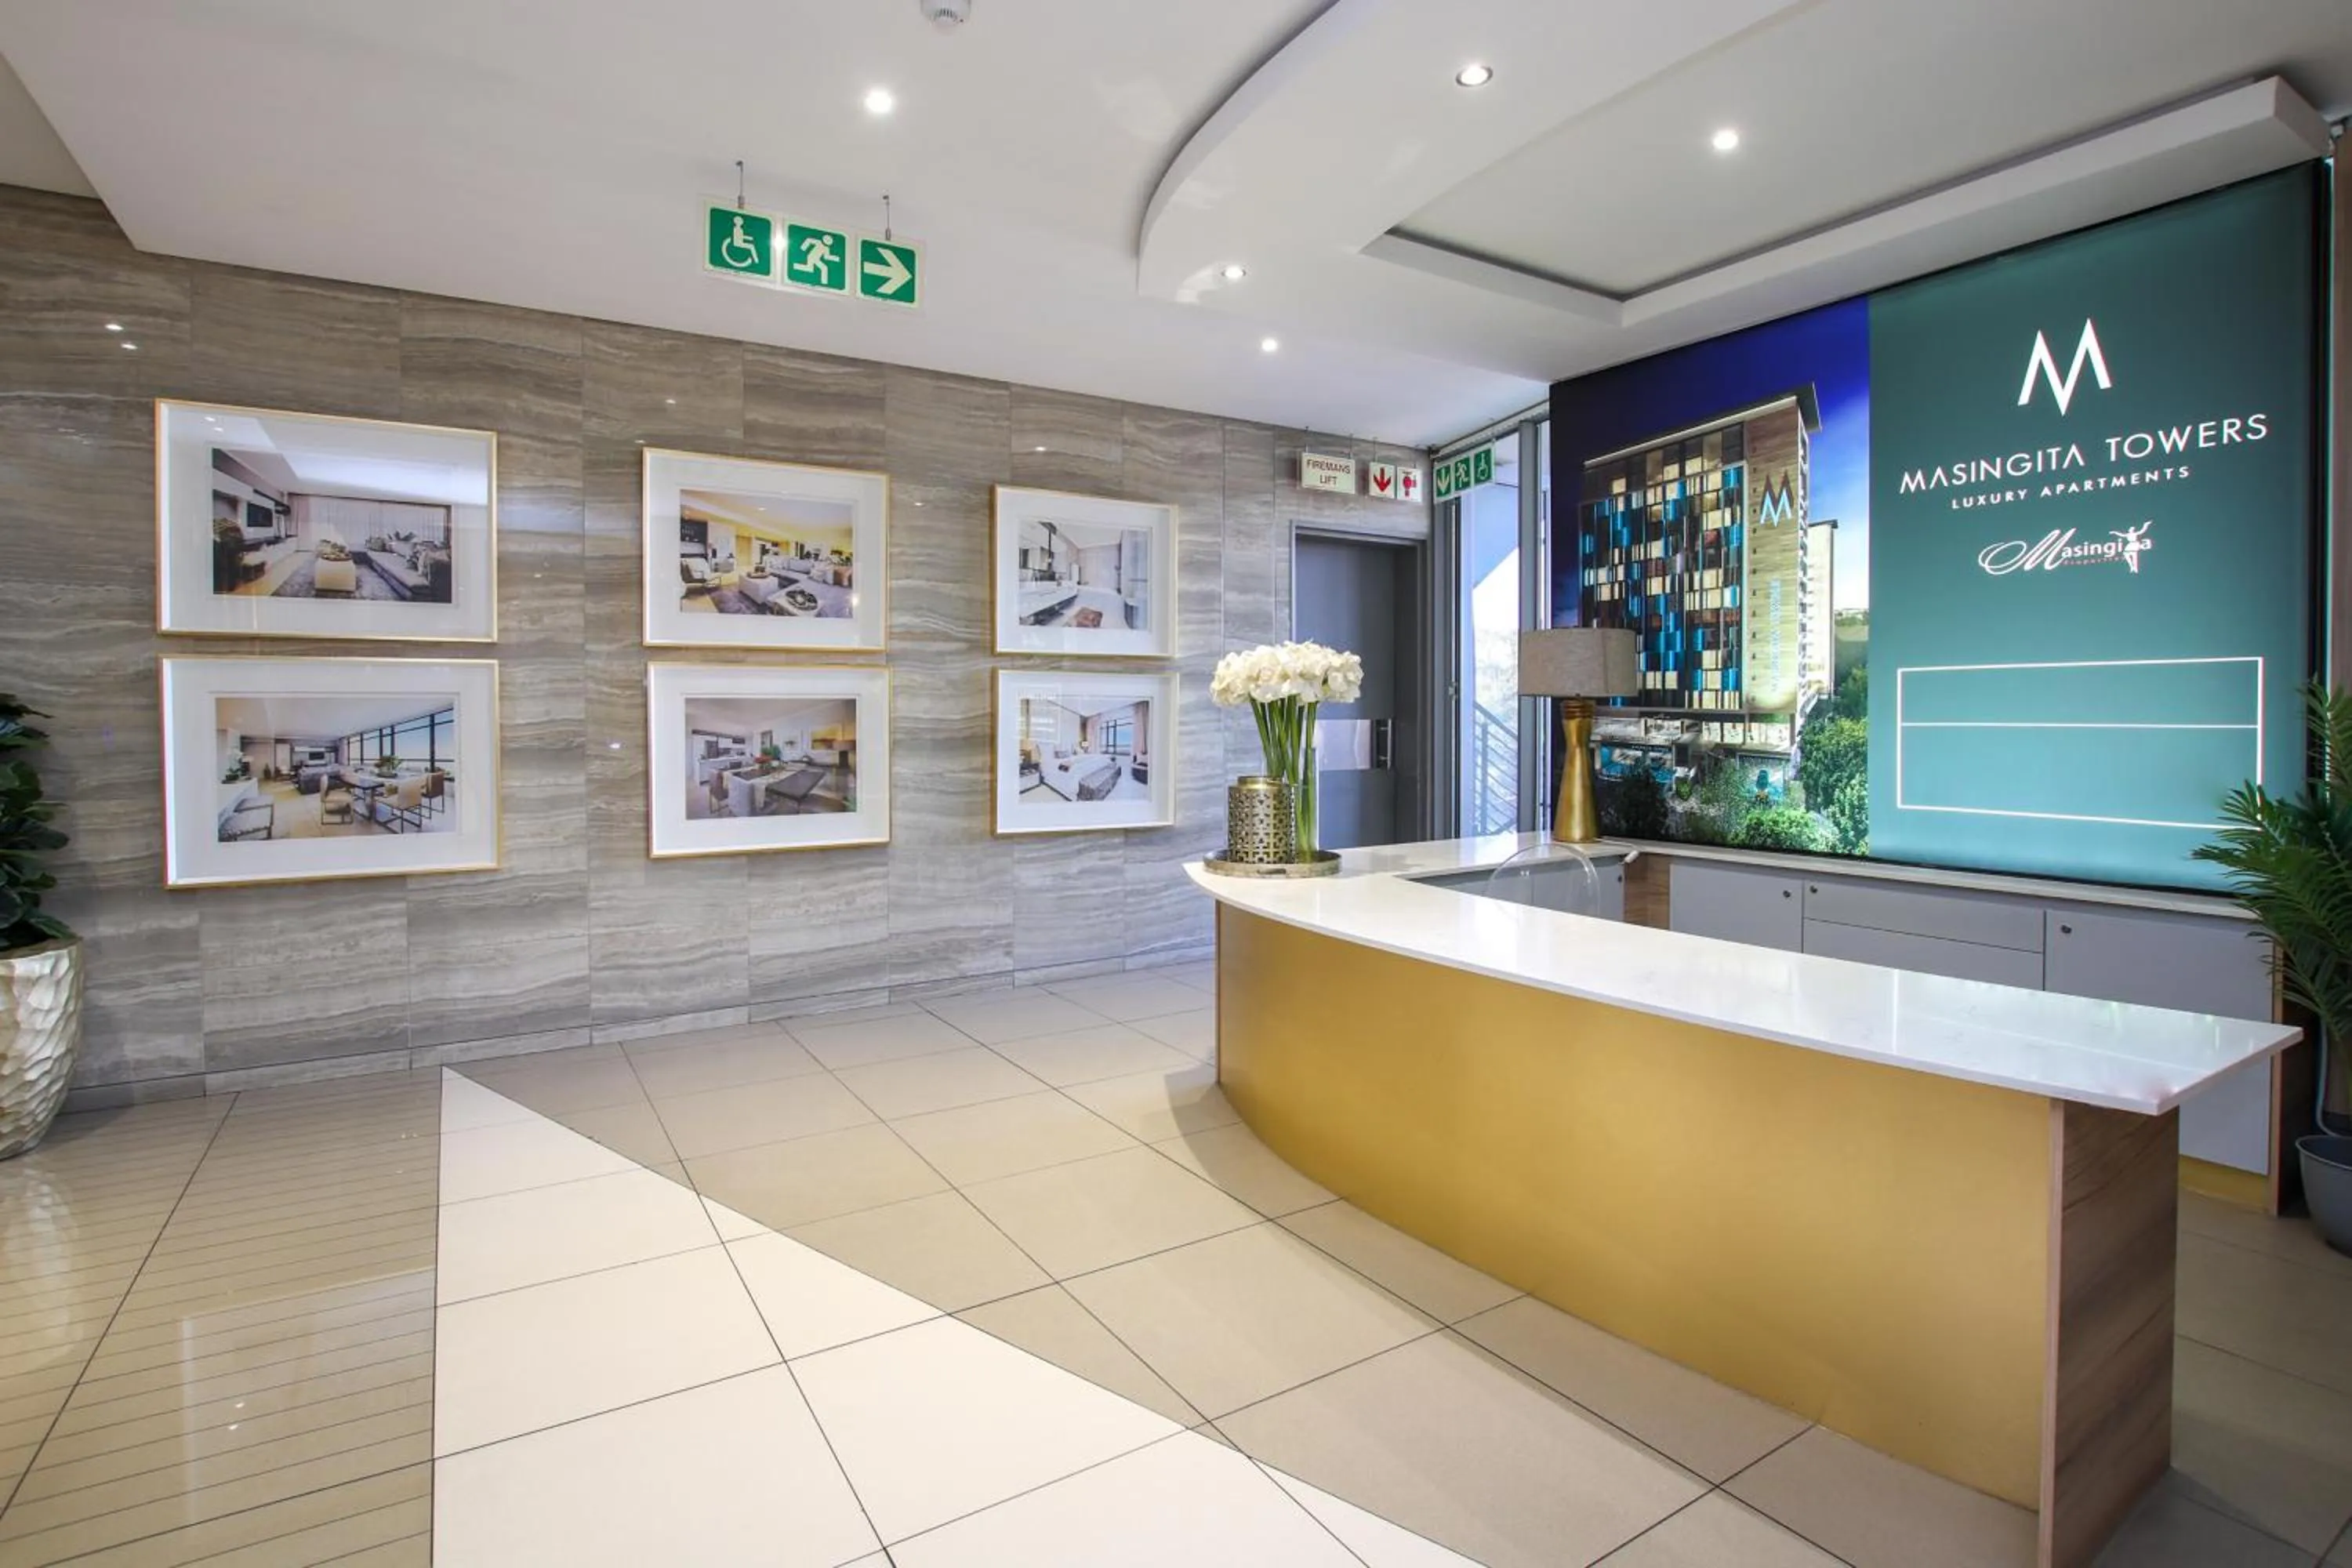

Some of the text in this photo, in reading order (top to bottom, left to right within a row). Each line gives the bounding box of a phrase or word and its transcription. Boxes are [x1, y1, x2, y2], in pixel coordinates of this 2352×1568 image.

[2017, 318, 2112, 416] M
[1306, 459, 1351, 474] FIREMANS
[1899, 413, 2268, 494] MASINGITA TOWERS
[1319, 474, 1338, 485] LIFT
[1951, 466, 2190, 510] LUXURY APARTMENTS
[1978, 528, 2152, 575] Masingia
